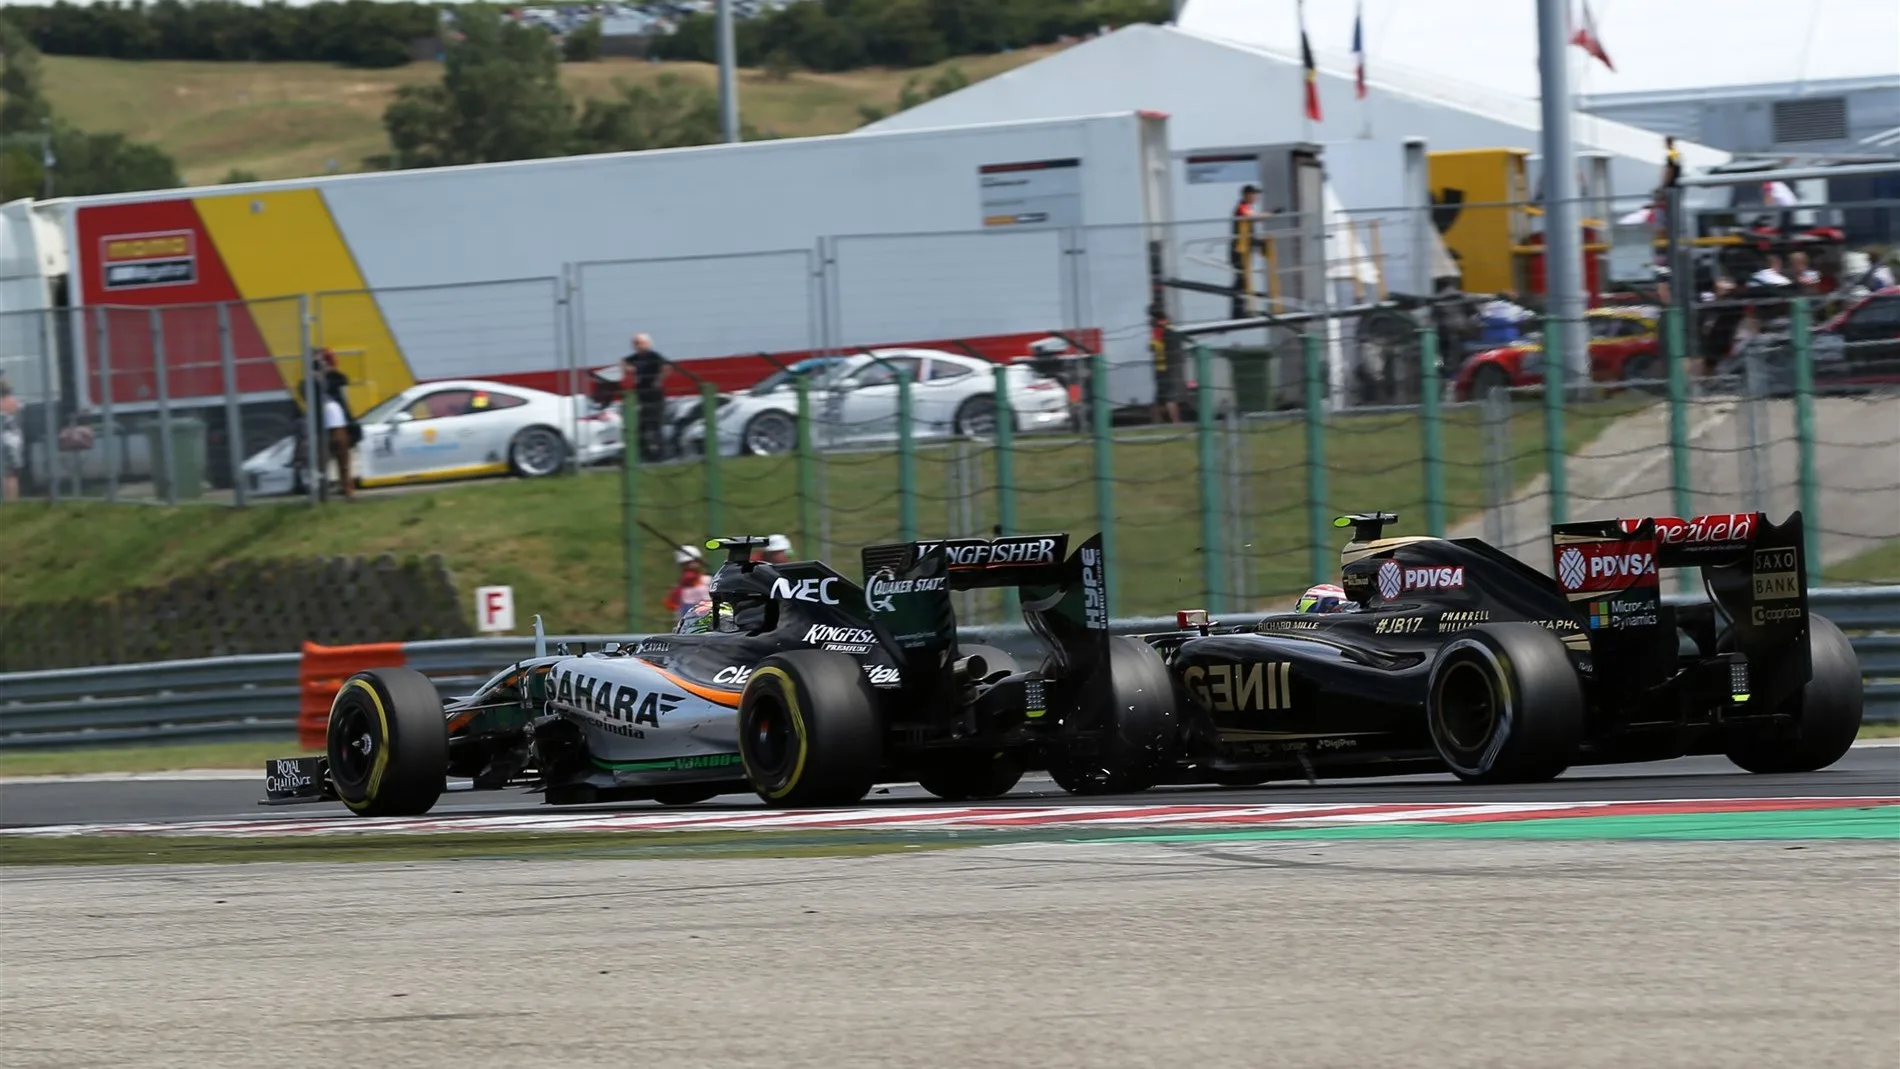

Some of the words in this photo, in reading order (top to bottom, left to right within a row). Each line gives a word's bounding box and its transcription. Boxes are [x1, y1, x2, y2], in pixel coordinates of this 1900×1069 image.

[1621, 514, 1751, 544] Vnezuela
[917, 539, 1056, 564] KNGFISHER
[1590, 553, 1656, 578] PDVSA
[1756, 552, 1794, 570] SAXO
[873, 579, 913, 596] QUAKER
[1404, 568, 1463, 589] PDVSA
[1755, 577, 1797, 594] BANK
[770, 577, 839, 605] NEC
[1081, 548, 1100, 629] HYPE
[485, 592, 503, 625] F
[1440, 610, 1490, 621] PHARRELL
[1257, 621, 1292, 631] RICHARD
[1292, 620, 1320, 630] MILLE
[1375, 616, 1423, 634] #JB17
[1438, 621, 1481, 633] WILLIA
[825, 643, 867, 652] PREMIUM
[545, 666, 660, 729] SAHARA
[277, 759, 300, 777] ROYAL
